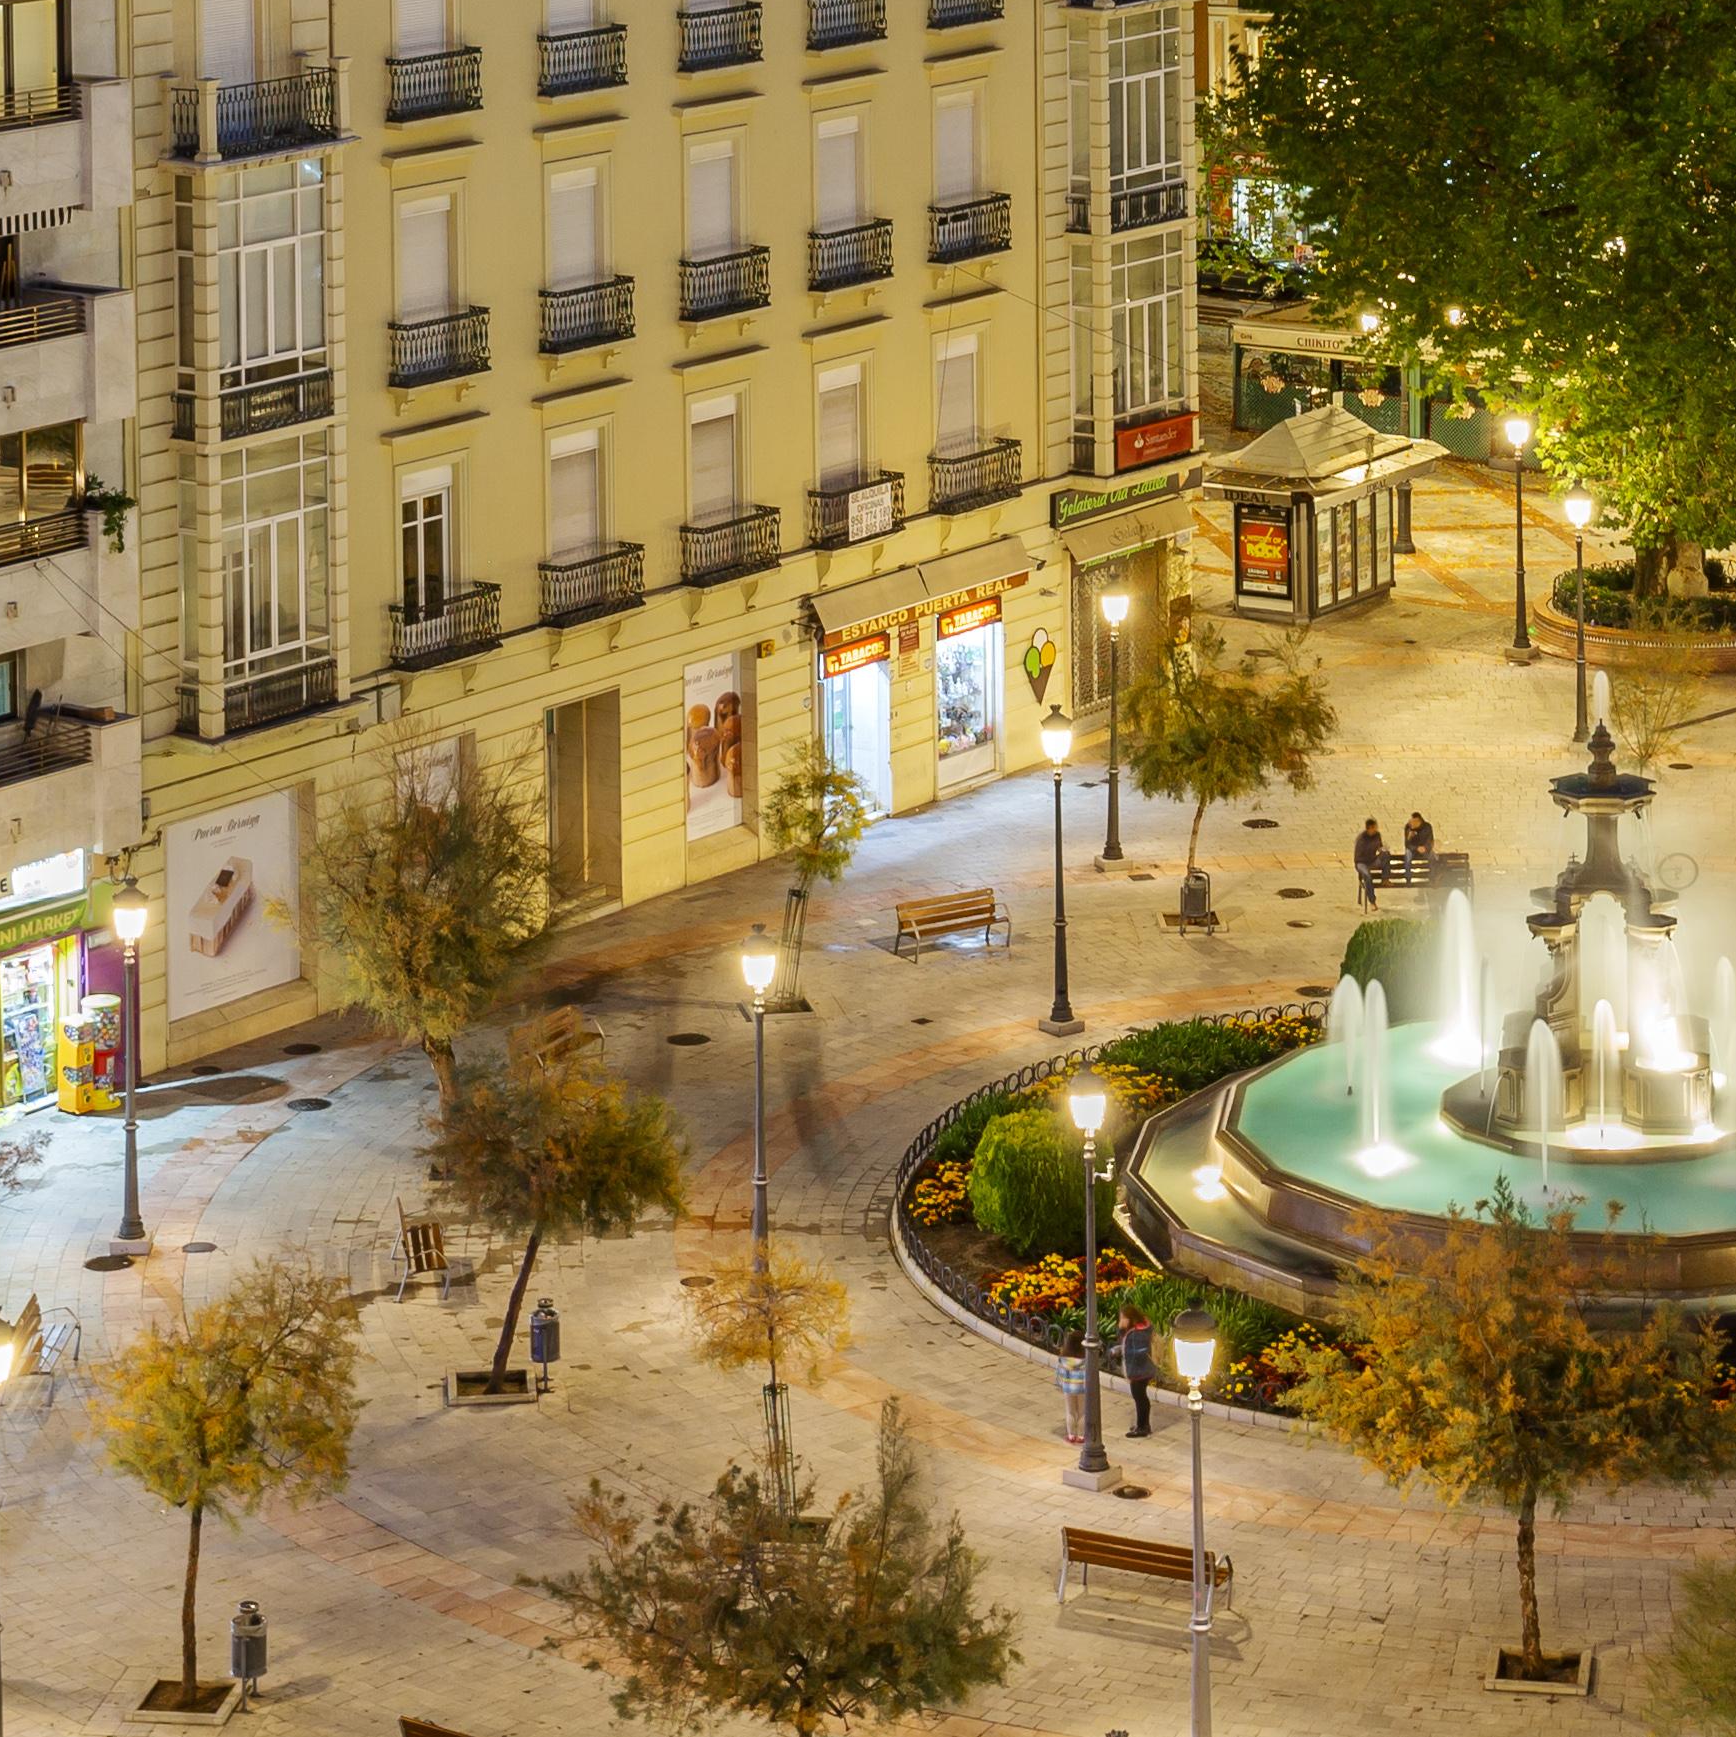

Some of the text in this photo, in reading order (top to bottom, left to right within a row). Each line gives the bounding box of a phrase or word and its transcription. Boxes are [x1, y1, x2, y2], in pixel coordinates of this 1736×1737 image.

[1297, 337, 1340, 350] CHIKITO
[862, 484, 889, 500] ALQUILA
[1223, 489, 1271, 504] IDEAL
[1246, 542, 1283, 559] ROCK
[841, 610, 909, 642] ESTANCO
[915, 589, 970, 618] PUERTA
[976, 578, 1012, 598] REAL
[953, 603, 997, 626] TABACOS
[839, 640, 885, 665] TABACOS
[21, 907, 79, 940] MARKET
